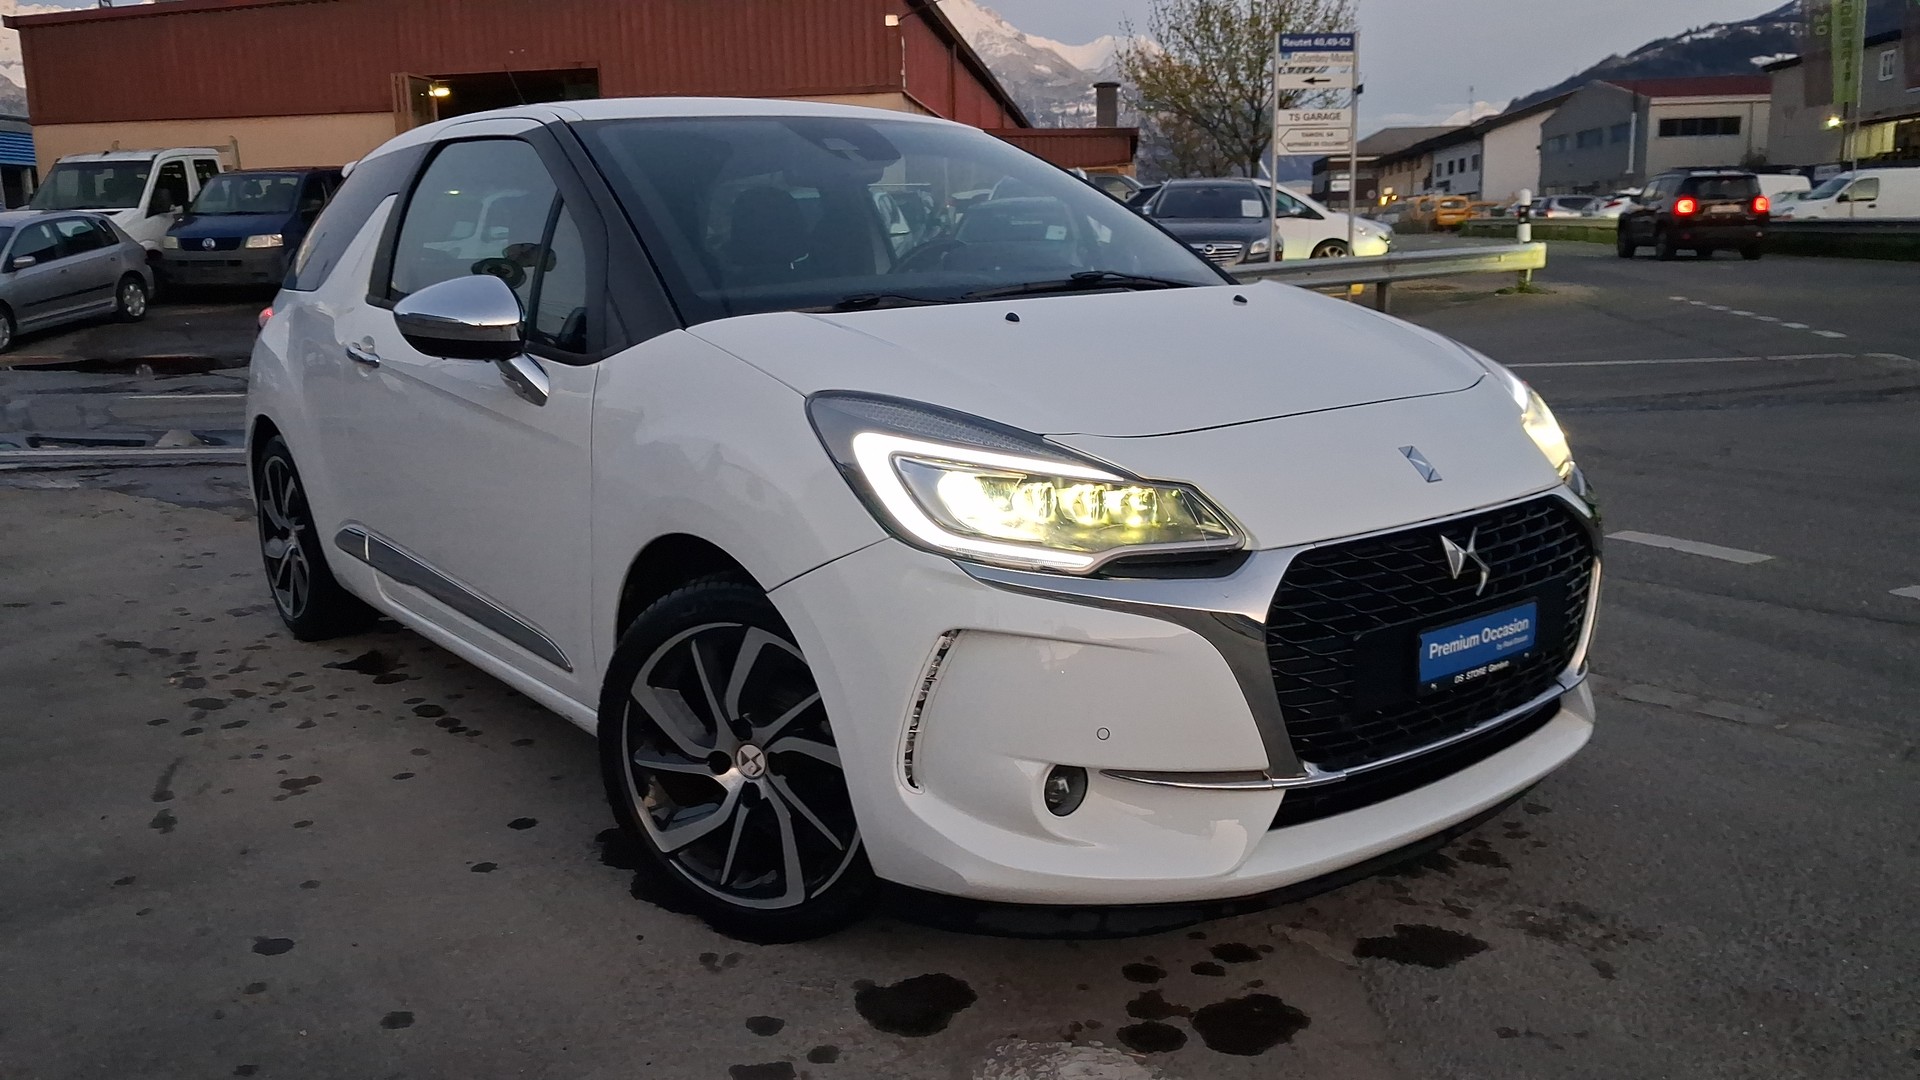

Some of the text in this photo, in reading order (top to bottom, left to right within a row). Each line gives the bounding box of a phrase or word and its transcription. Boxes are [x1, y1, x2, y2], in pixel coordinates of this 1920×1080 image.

[1289, 112, 1341, 121] TS GARAGE
[1429, 633, 1480, 659] Premium
[1481, 618, 1529, 643] Occasion
